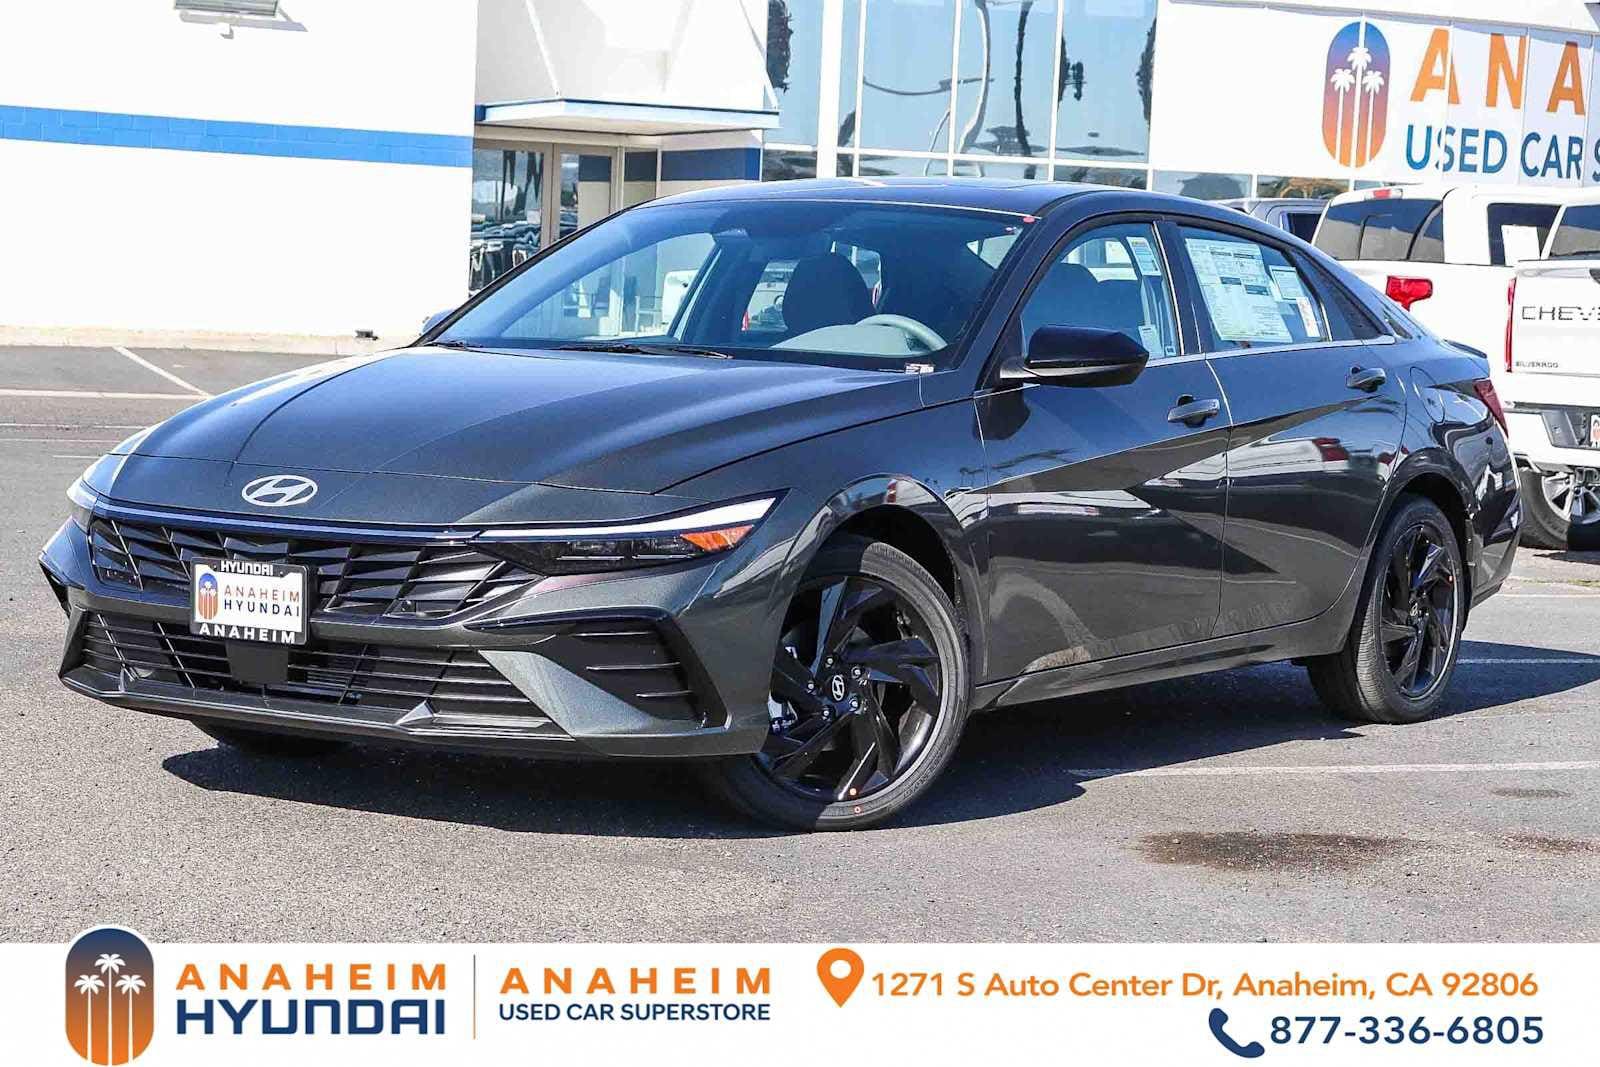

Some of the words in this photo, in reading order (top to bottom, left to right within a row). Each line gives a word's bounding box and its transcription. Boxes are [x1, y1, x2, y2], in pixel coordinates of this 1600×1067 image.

[1405, 125, 1508, 174] USED
[1520, 132, 1584, 180] CAR
[220, 560, 274, 576] HYUNDAI
[224, 584, 300, 602] ANAHEIM
[224, 599, 300, 617] HYUNDAI
[199, 622, 296, 645] ANAHEIM
